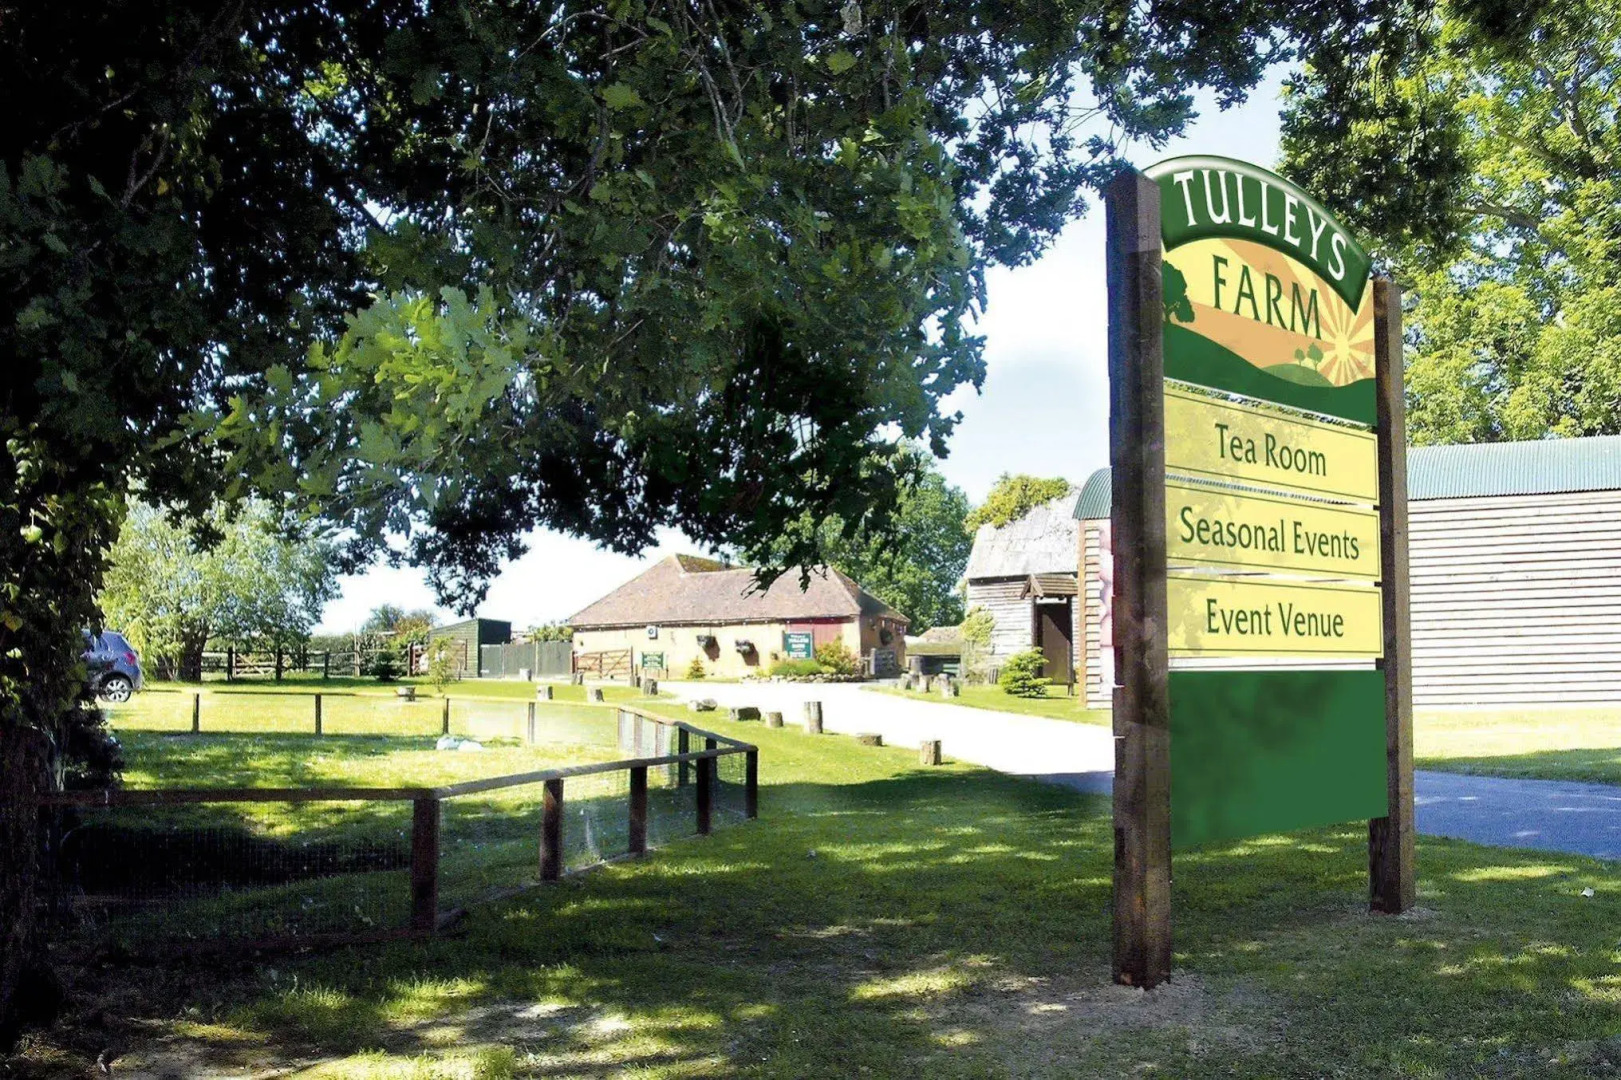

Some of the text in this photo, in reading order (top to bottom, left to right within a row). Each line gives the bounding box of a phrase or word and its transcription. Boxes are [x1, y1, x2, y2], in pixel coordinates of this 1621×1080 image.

[1174, 169, 1347, 281] TULLEYS
[1213, 255, 1321, 340] FARM
[1215, 423, 1327, 476] Tea Room
[1180, 506, 1360, 560] Seasonal Events
[1206, 598, 1344, 638] Event Venue
